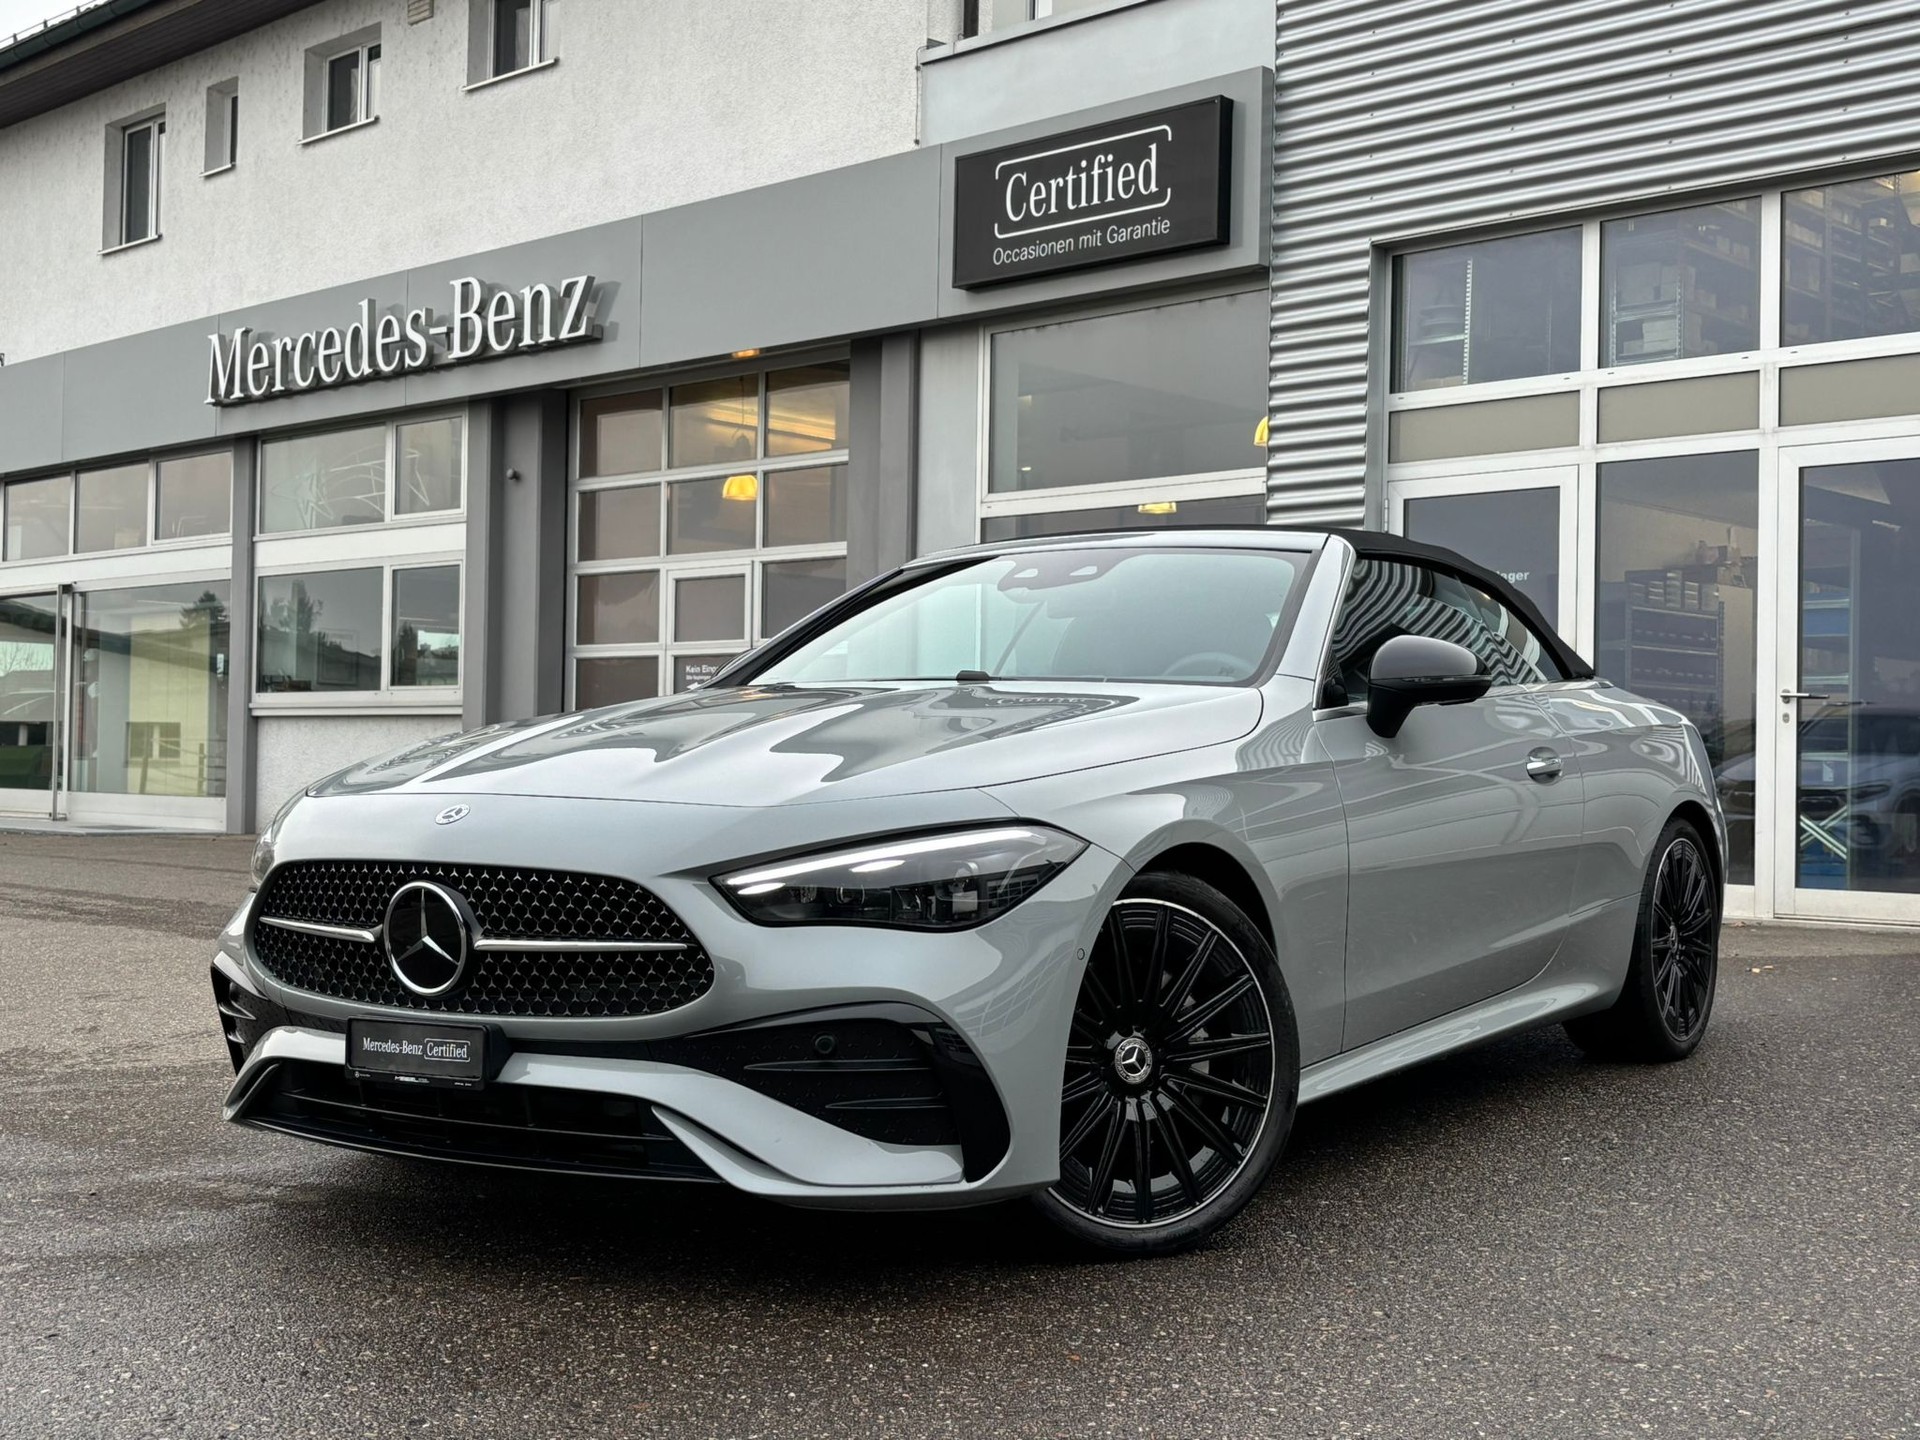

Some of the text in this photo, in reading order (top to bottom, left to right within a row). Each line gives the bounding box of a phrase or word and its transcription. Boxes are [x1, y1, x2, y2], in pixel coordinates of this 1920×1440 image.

[1005, 142, 1159, 222] Certified
[993, 216, 1170, 265] Occasionen mit Garantie
[204, 275, 596, 404] Mercedes-Benz
[1496, 570, 1530, 584] ager
[363, 1037, 468, 1059] Mercedes-Benz Certified
